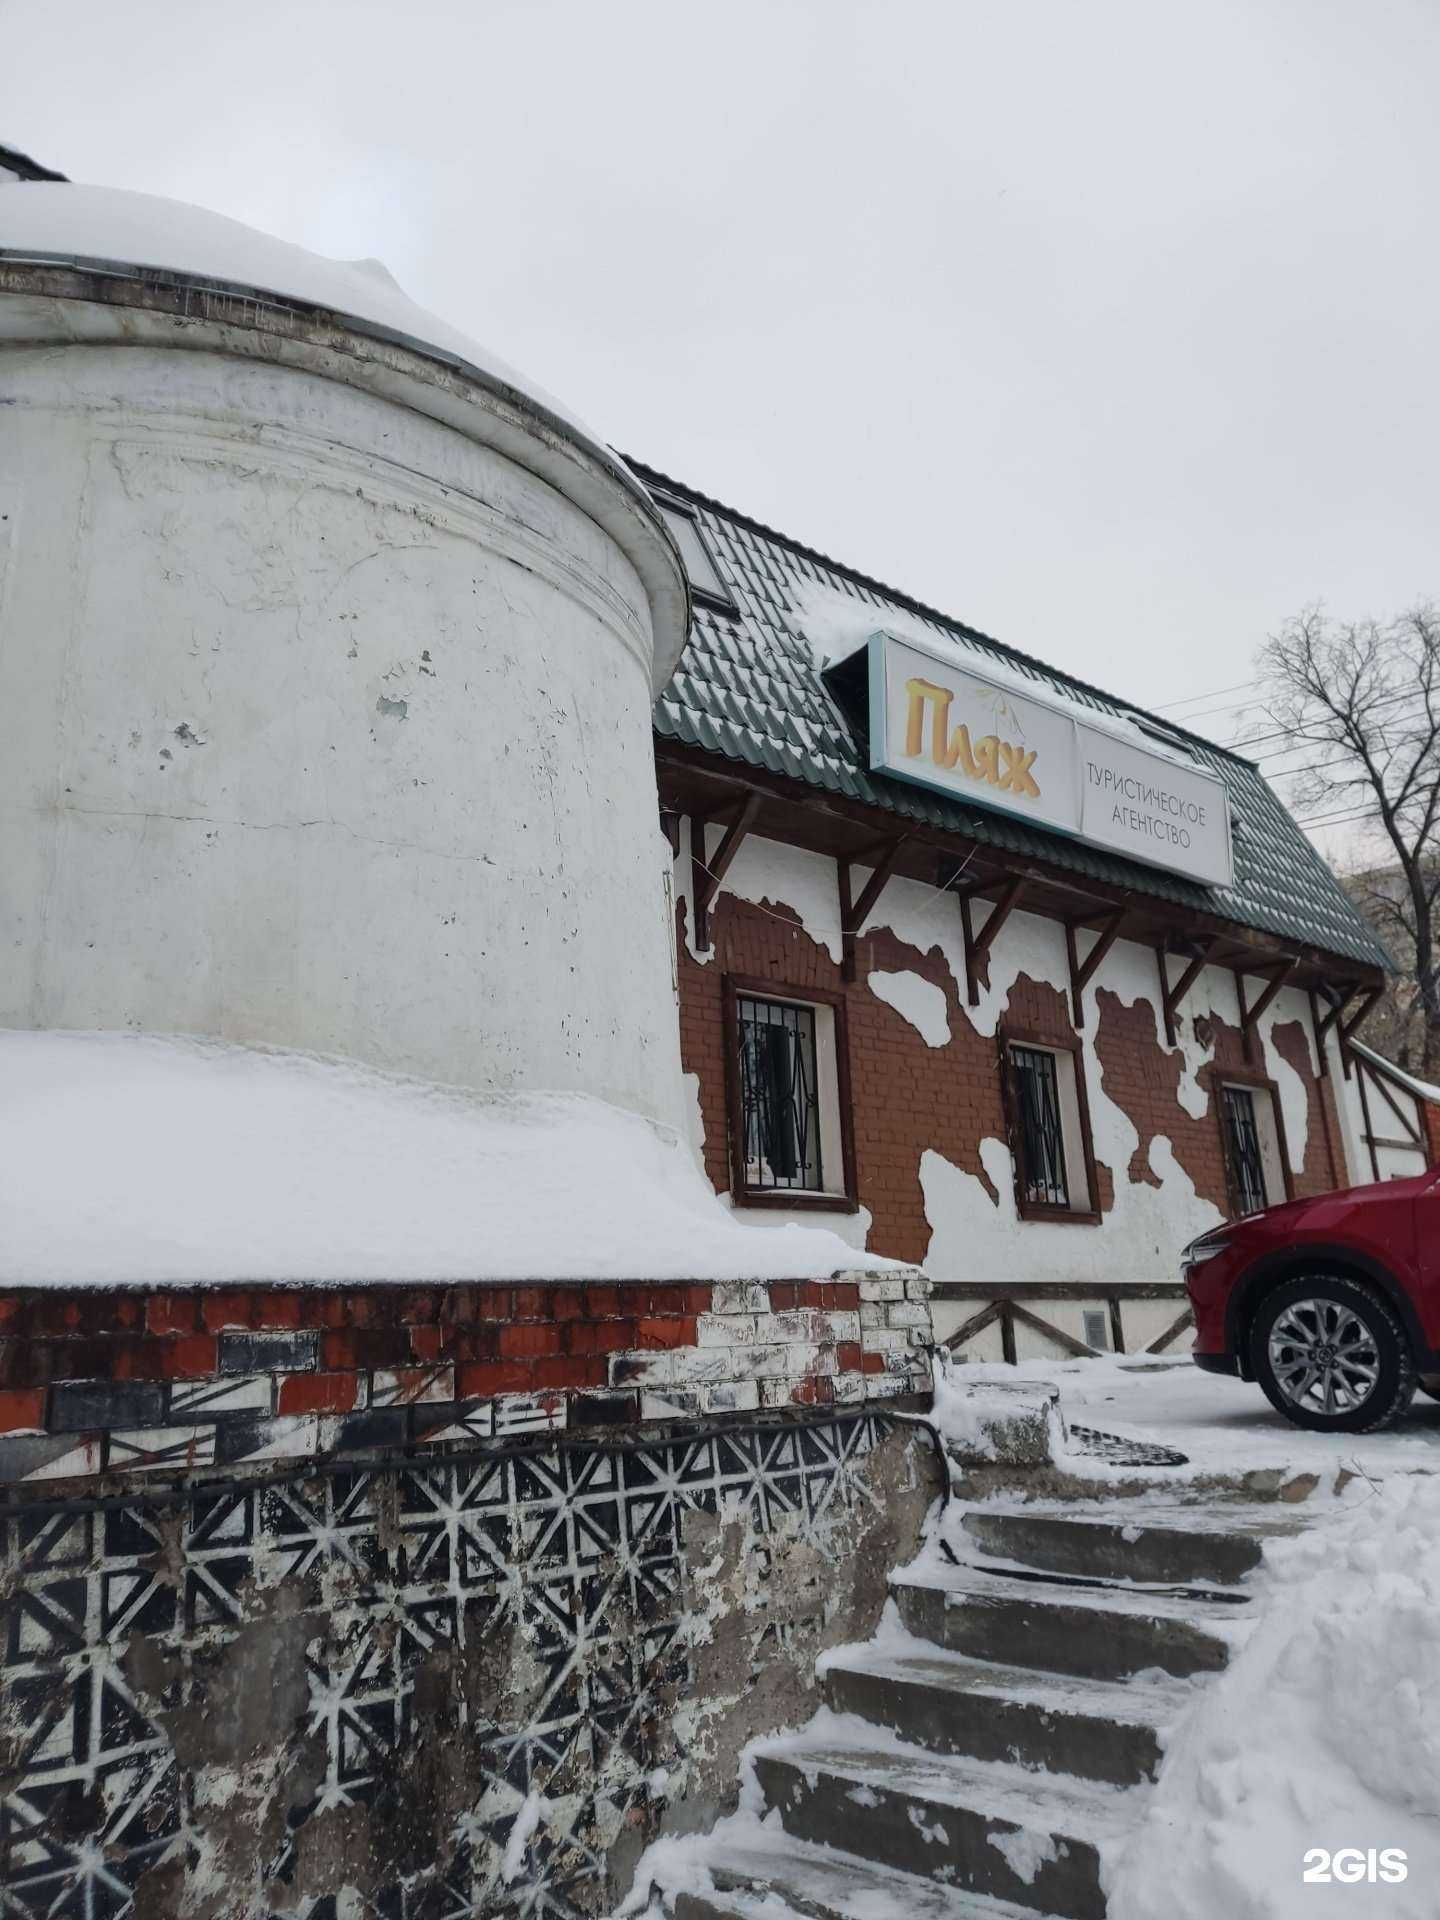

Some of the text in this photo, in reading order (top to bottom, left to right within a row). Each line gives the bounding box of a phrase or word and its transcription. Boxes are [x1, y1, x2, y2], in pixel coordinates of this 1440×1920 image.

[906, 678, 1041, 797] Пляж
[1087, 762, 1206, 827] ТУРИСТИЧЕСКОЕ
[1112, 805, 1191, 849] АГЕНТСТВО
